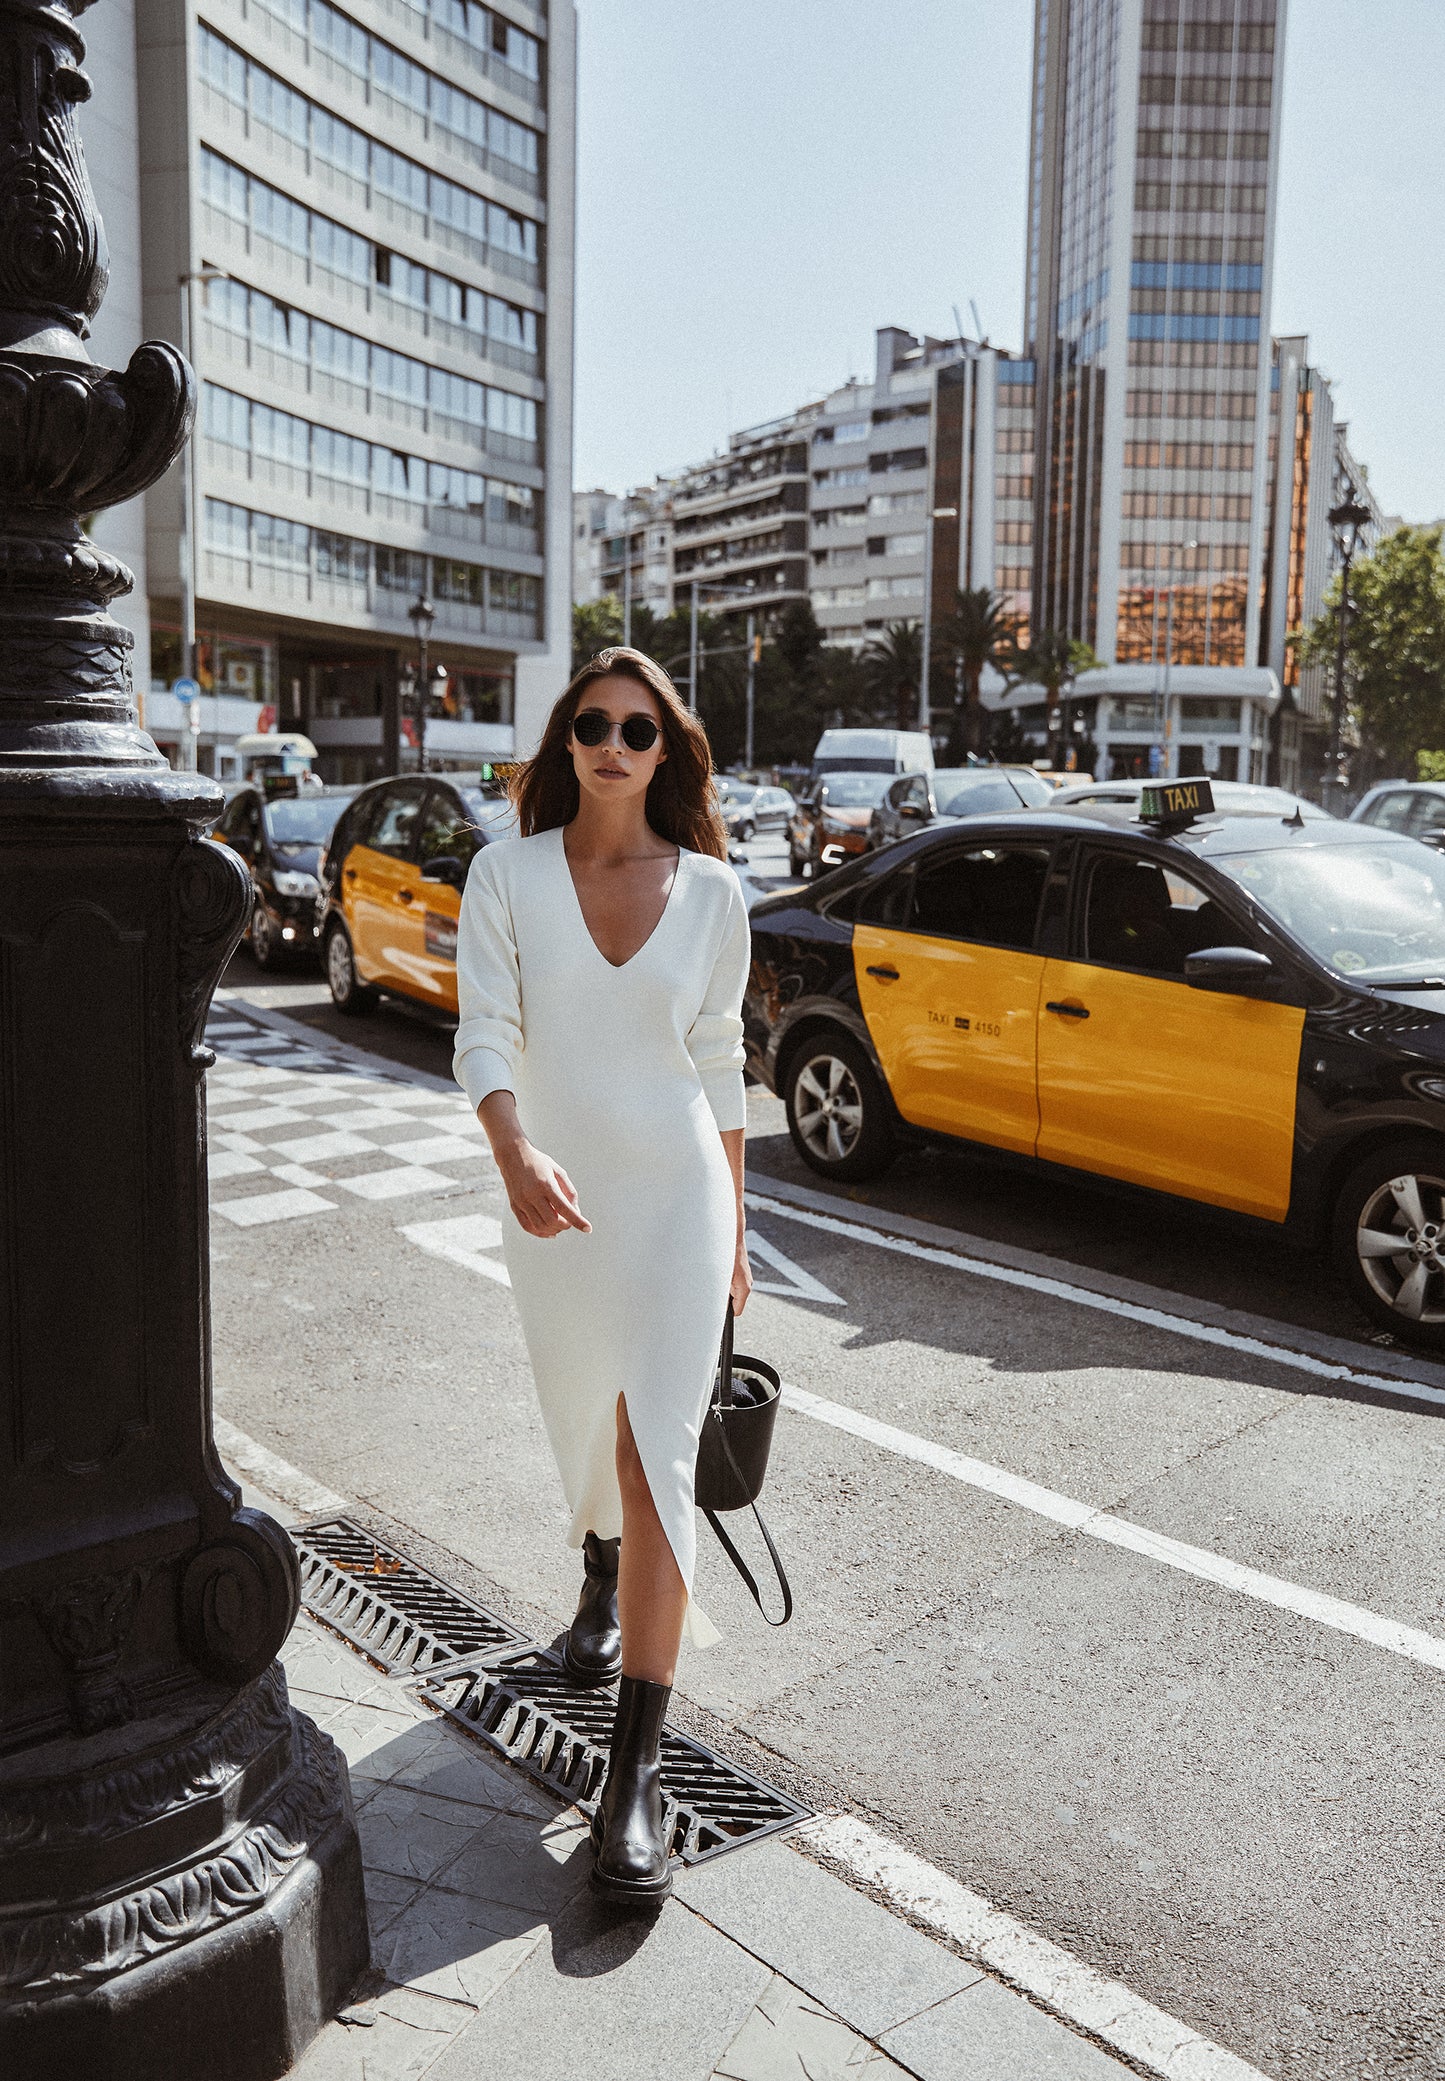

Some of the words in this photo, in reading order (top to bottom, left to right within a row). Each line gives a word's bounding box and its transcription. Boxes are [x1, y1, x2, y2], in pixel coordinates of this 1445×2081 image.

[1165, 785, 1199, 812] TAXI
[928, 1010, 949, 1025] TAXI
[974, 1022, 1000, 1036] 4150
